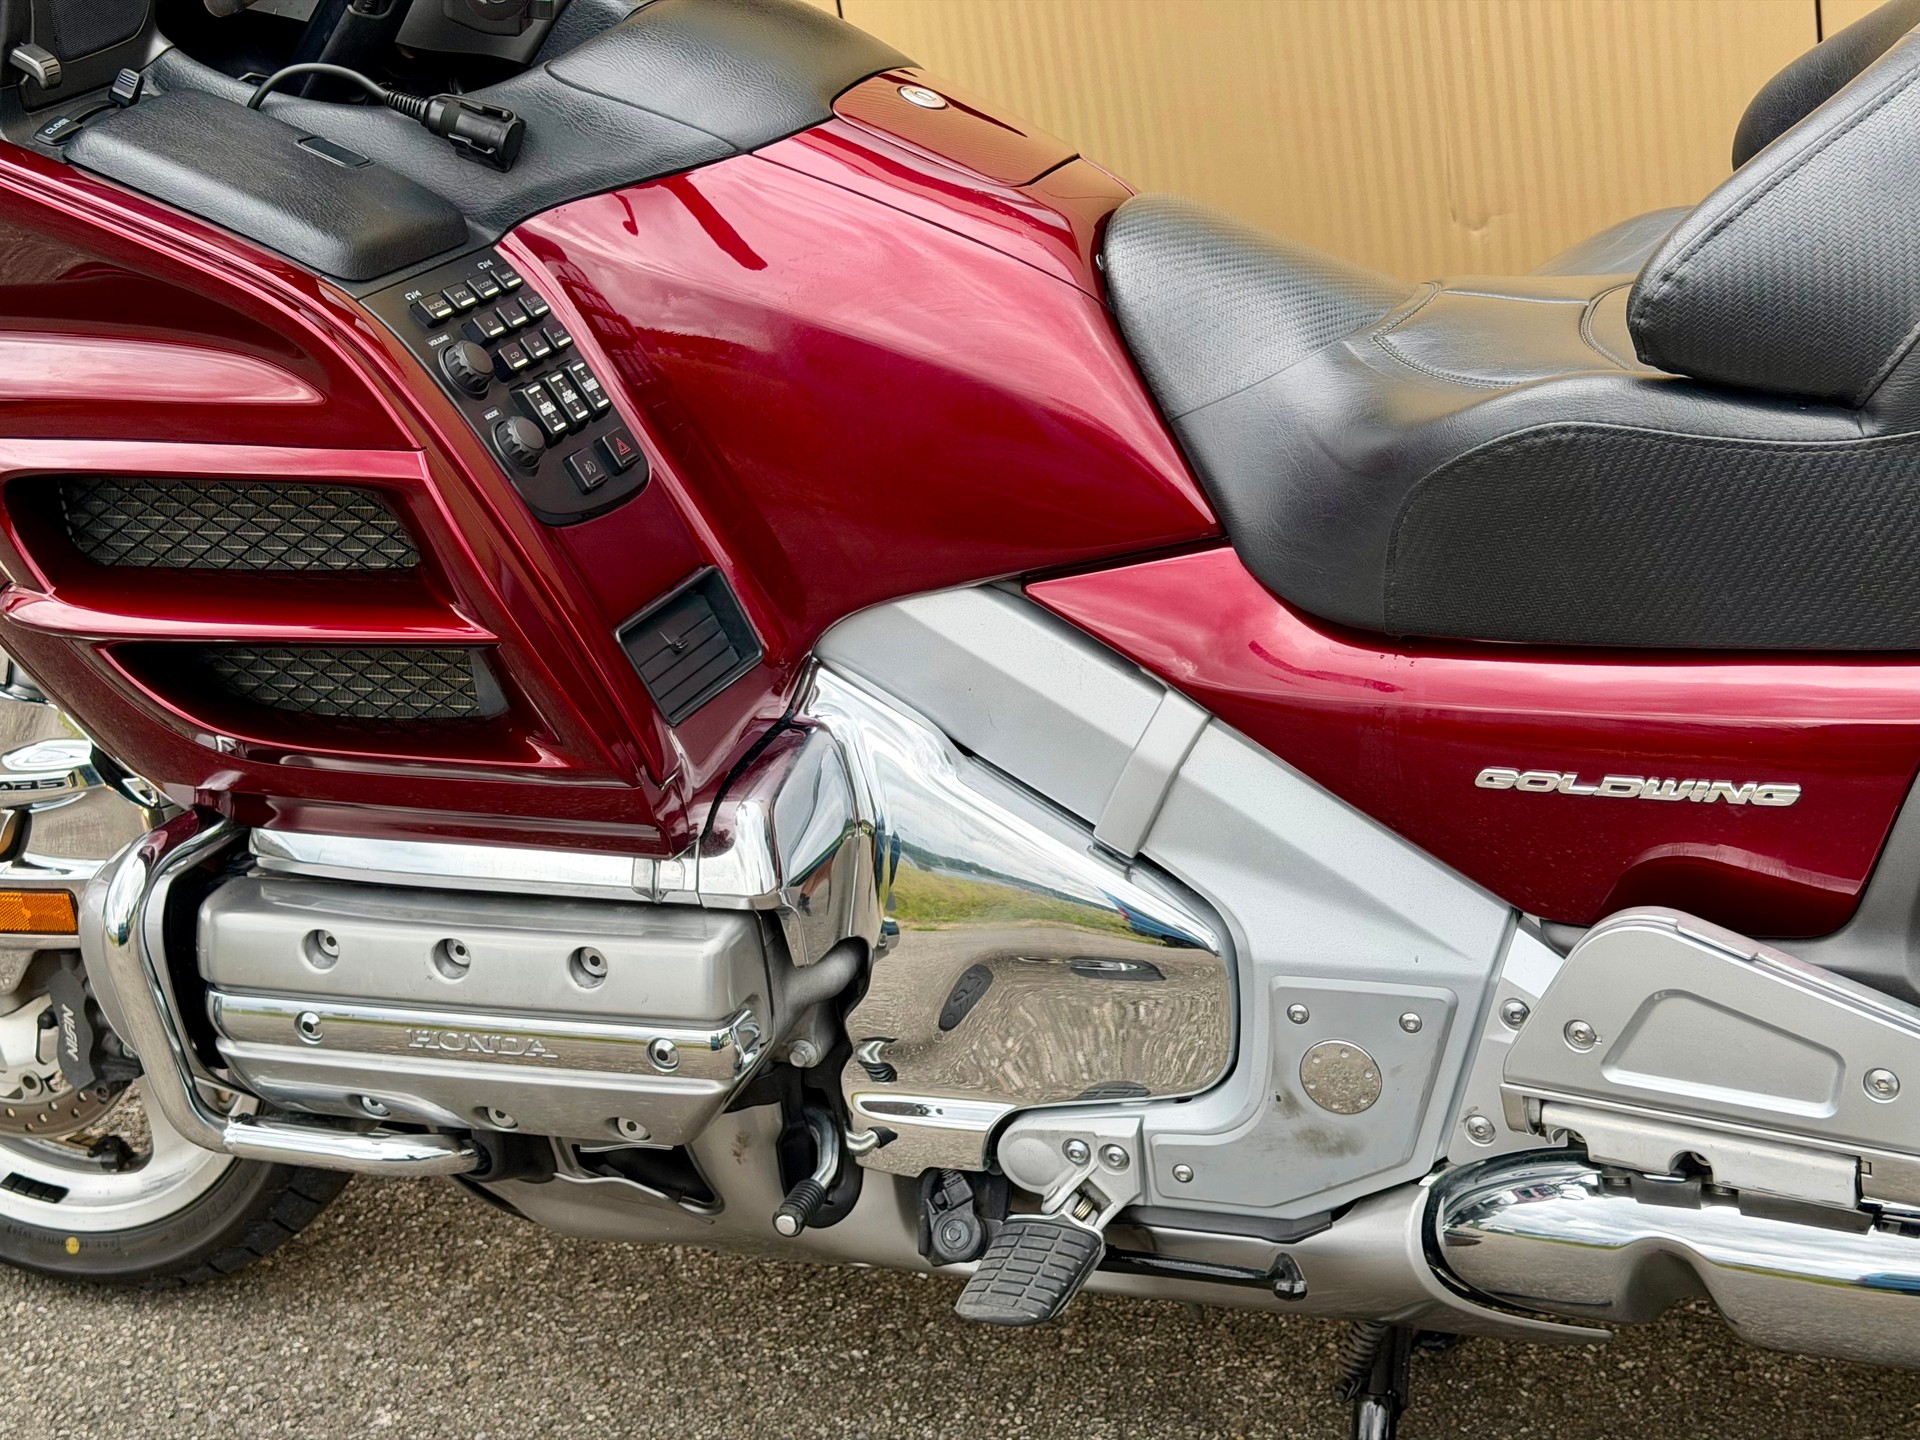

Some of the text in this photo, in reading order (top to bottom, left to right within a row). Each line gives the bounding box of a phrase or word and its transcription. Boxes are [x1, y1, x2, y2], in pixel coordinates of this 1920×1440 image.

[44, 117, 71, 135] CLOSE
[454, 290, 468, 299] PTY
[428, 300, 447, 310] AUDIO
[428, 334, 450, 347] VOLUME
[510, 351, 520, 359] CD
[484, 410, 500, 421] MODE
[1474, 766, 1802, 807] GOLDWING
[61, 1003, 79, 1061] NISSIN
[405, 1028, 559, 1059] HONDA
